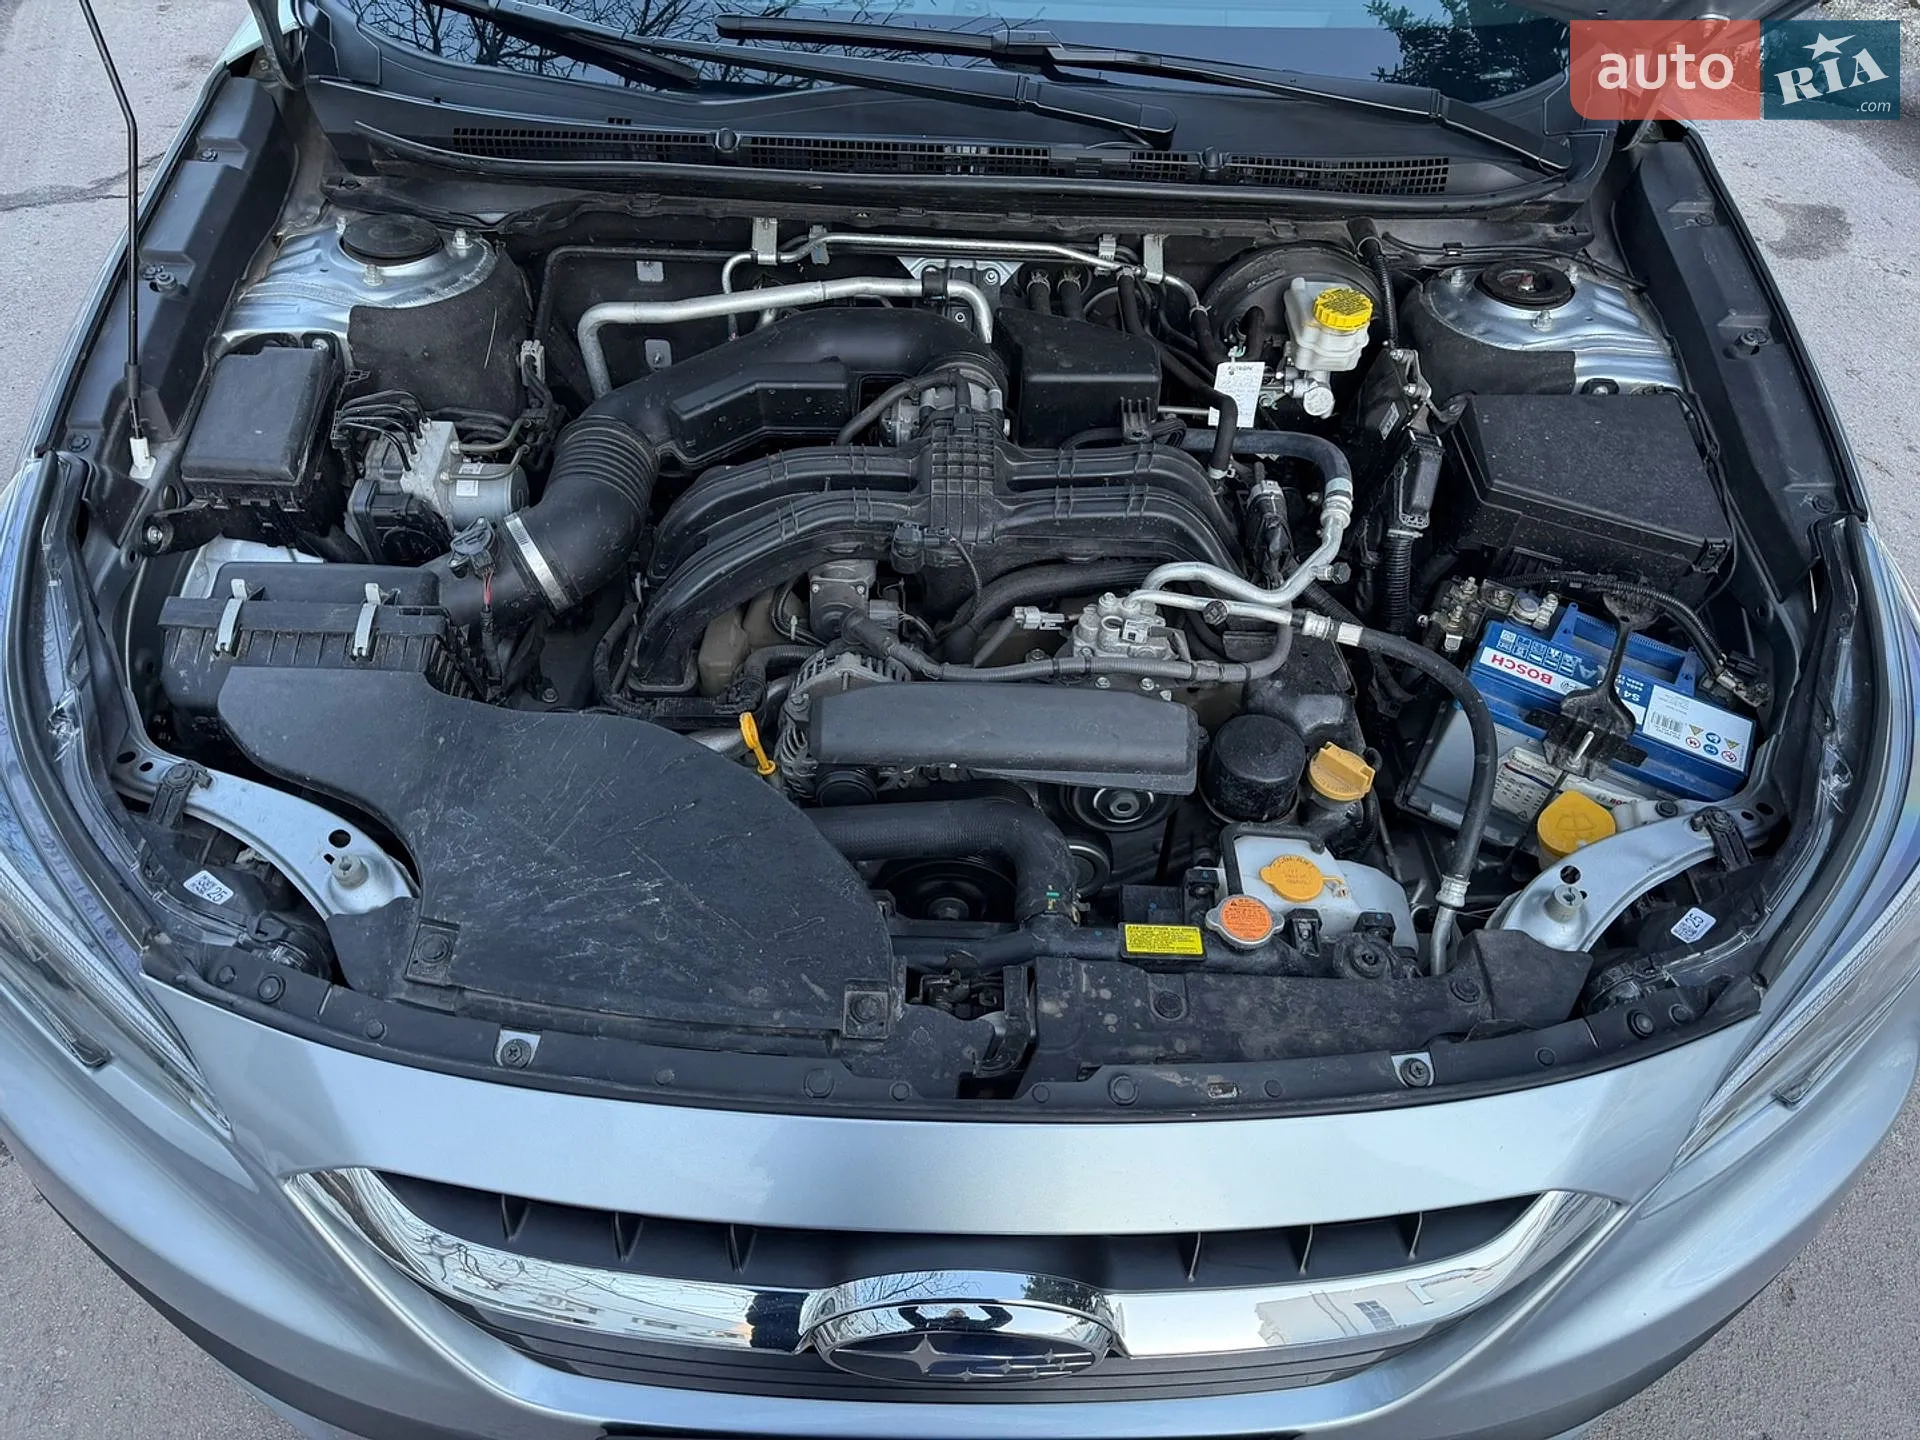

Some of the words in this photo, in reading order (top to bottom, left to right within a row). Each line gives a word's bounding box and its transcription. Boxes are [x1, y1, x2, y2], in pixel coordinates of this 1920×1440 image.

[1491, 654, 1553, 685] BOSCH
[206, 886, 228, 902] 25
[1685, 913, 1704, 928] 25
